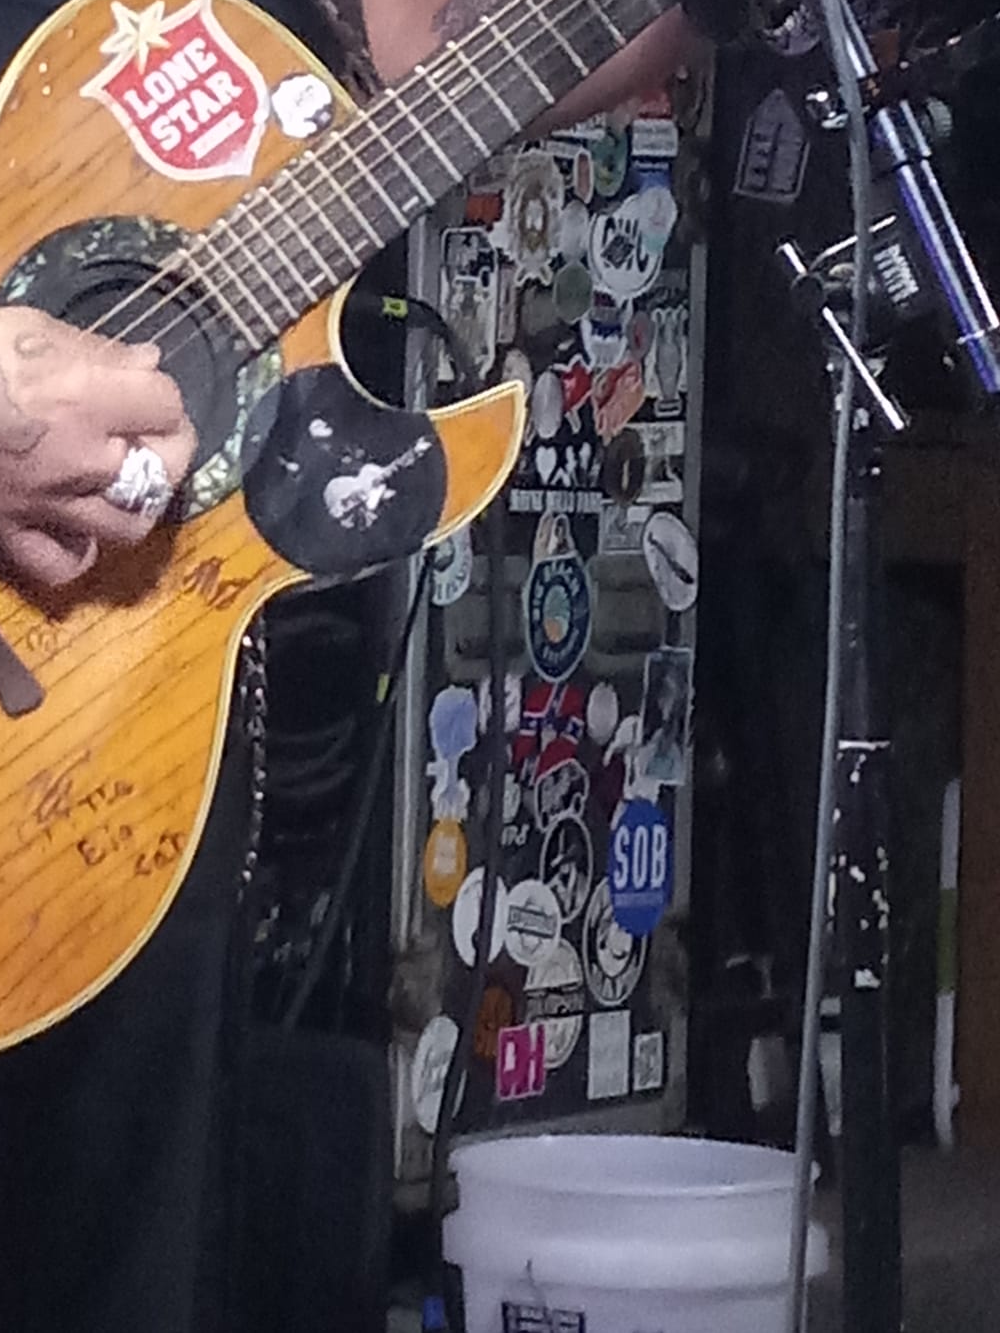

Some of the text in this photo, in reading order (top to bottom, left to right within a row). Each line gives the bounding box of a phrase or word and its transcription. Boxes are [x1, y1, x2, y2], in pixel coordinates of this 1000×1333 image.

[123, 36, 218, 120] LONE
[149, 70, 243, 152] STAR
[613, 823, 668, 891] SOB
